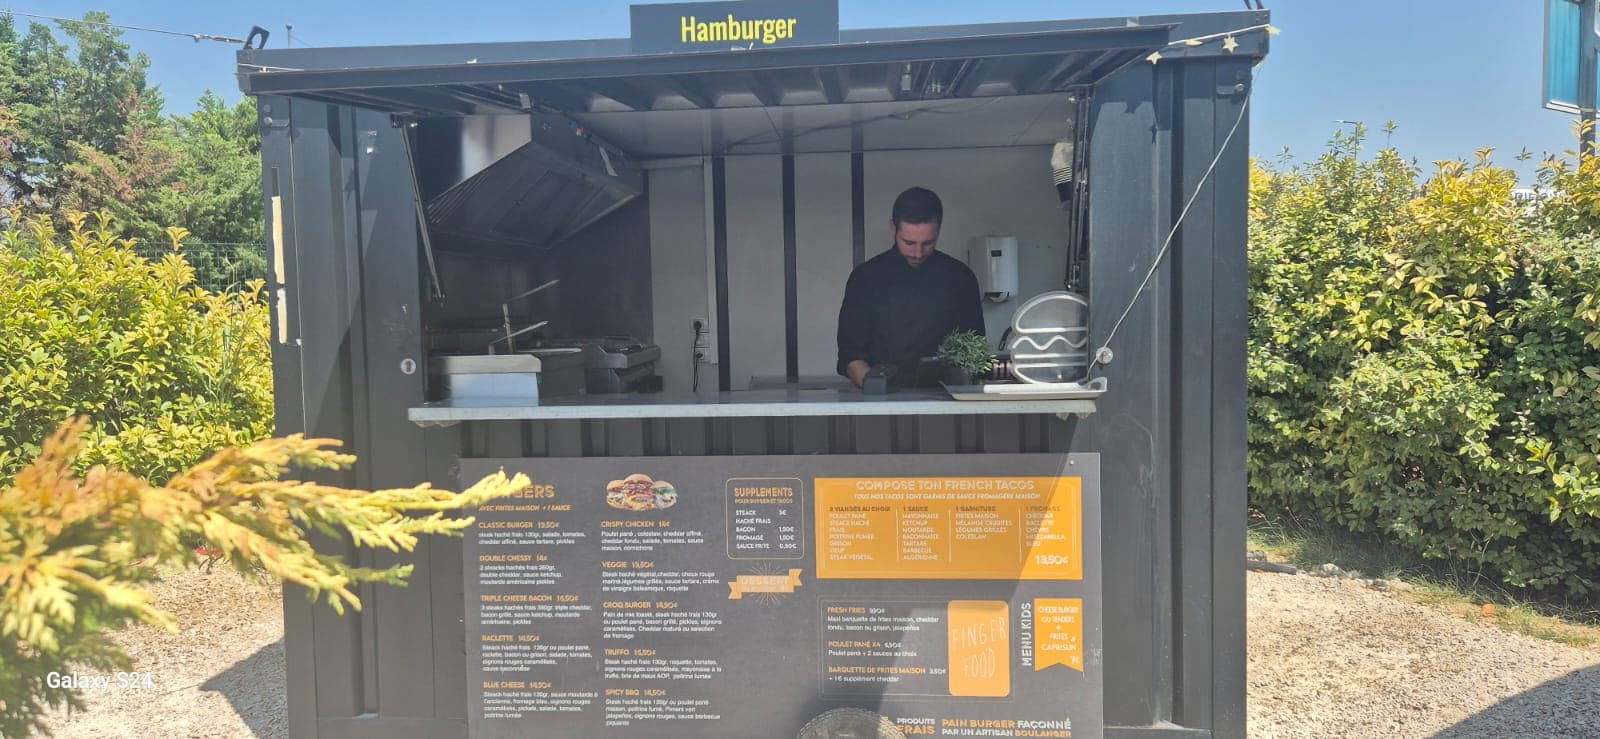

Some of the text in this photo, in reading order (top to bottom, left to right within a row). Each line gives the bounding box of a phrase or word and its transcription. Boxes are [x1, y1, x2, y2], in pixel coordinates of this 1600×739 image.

[681, 14, 796, 44] Hamburger
[856, 479, 1034, 491] COMPOSE TON FRENCH TACOS
[734, 487, 793, 497] SUPPLEMENTS
[481, 594, 502, 602] TRIPLE
[503, 594, 527, 602] CHEESE
[528, 594, 552, 602] BACON
[952, 617, 1007, 649] FINGER
[1021, 602, 1032, 667] MENU KIDS
[964, 648, 996, 679] FOOD
[828, 666, 866, 674] BARQUETTE
[867, 666, 876, 674] DE
[877, 666, 898, 674] FRITES
[899, 666, 926, 674] MAISON
[483, 681, 499, 689] BLUE
[500, 681, 525, 689] CHEESE
[942, 717, 1072, 731] PAIN BURGER FAÇONNÉ
[942, 728, 1072, 738] PAR UN ARTISAN BOULANGER
